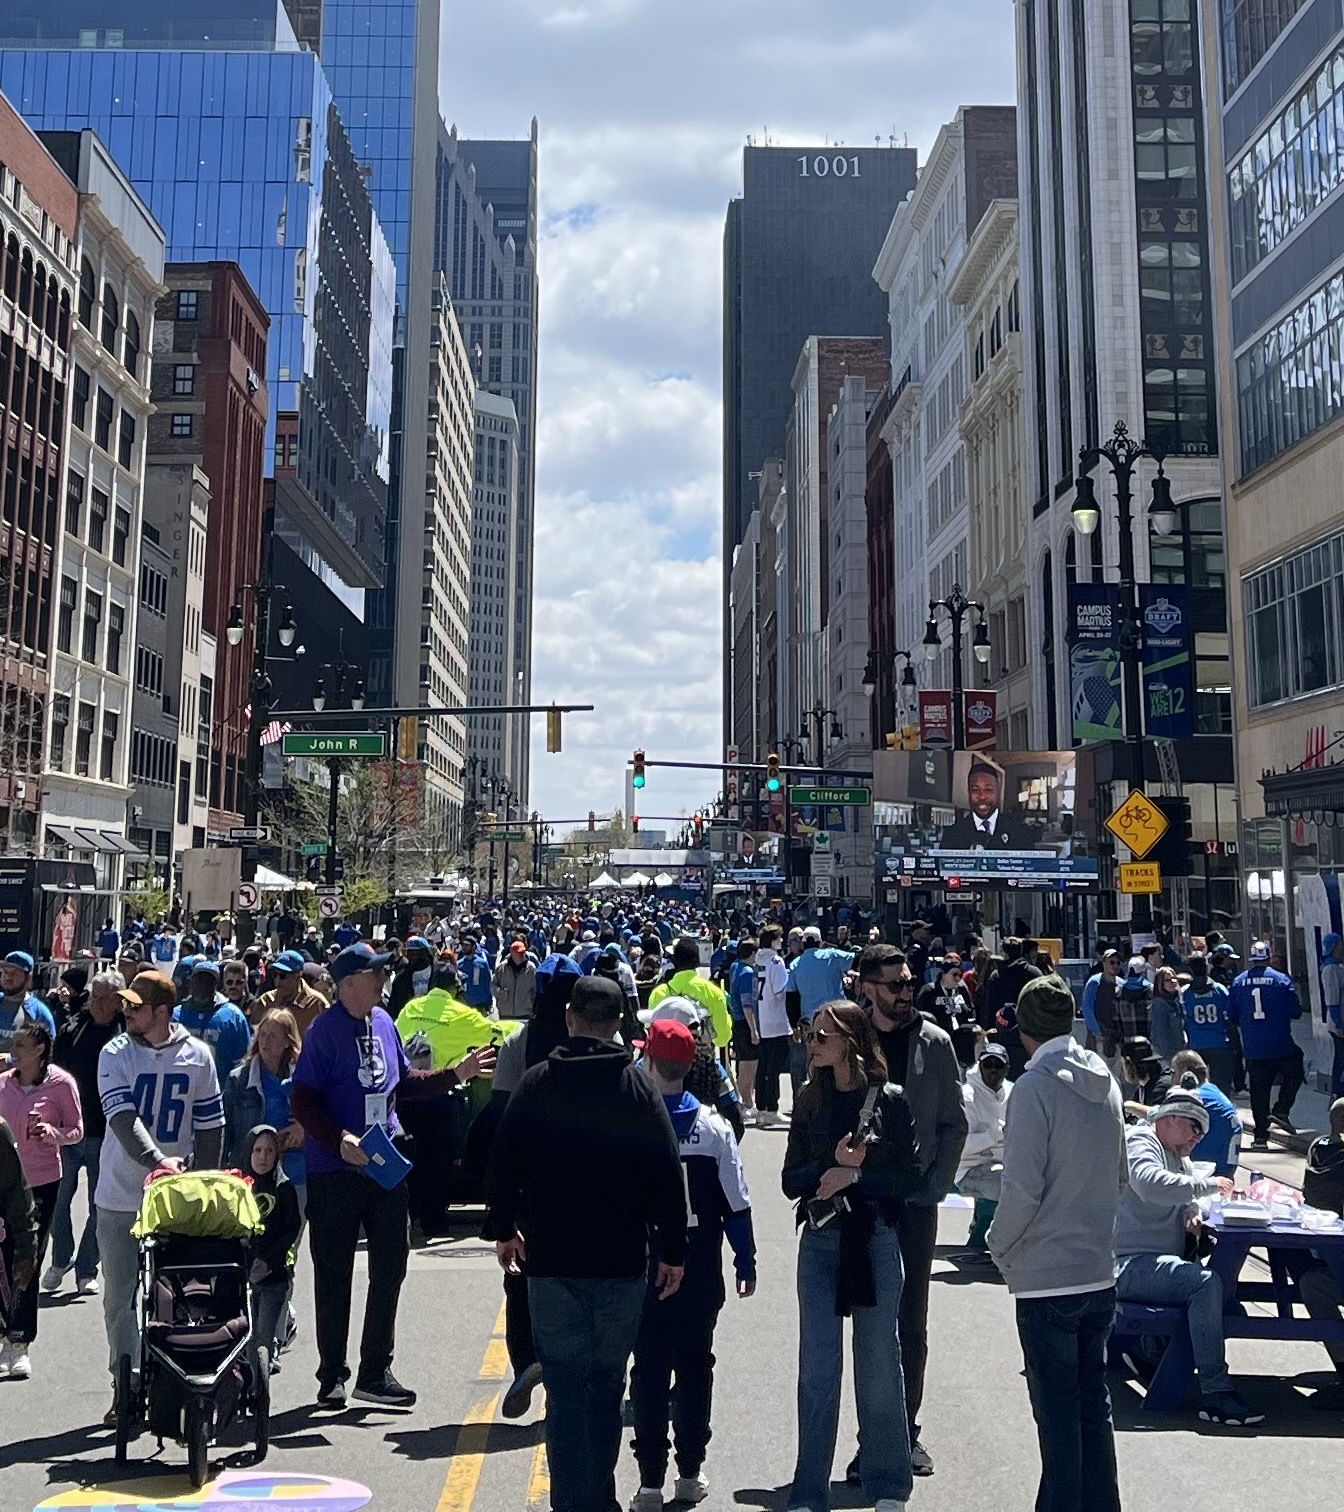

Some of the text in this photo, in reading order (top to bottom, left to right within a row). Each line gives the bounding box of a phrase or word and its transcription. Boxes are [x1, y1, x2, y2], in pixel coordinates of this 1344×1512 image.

[797, 155, 862, 177] 1001
[171, 473, 185, 578] SINGER
[1076, 605, 1112, 616] CAMPUS
[1077, 615, 1112, 626] MARTIUS
[1166, 687, 1186, 713] 12
[309, 738, 358, 750] John R
[809, 791, 850, 801] Clifford
[1125, 869, 1155, 877] TRACKS
[816, 886, 830, 896] 25
[1251, 988, 1266, 1020] 1
